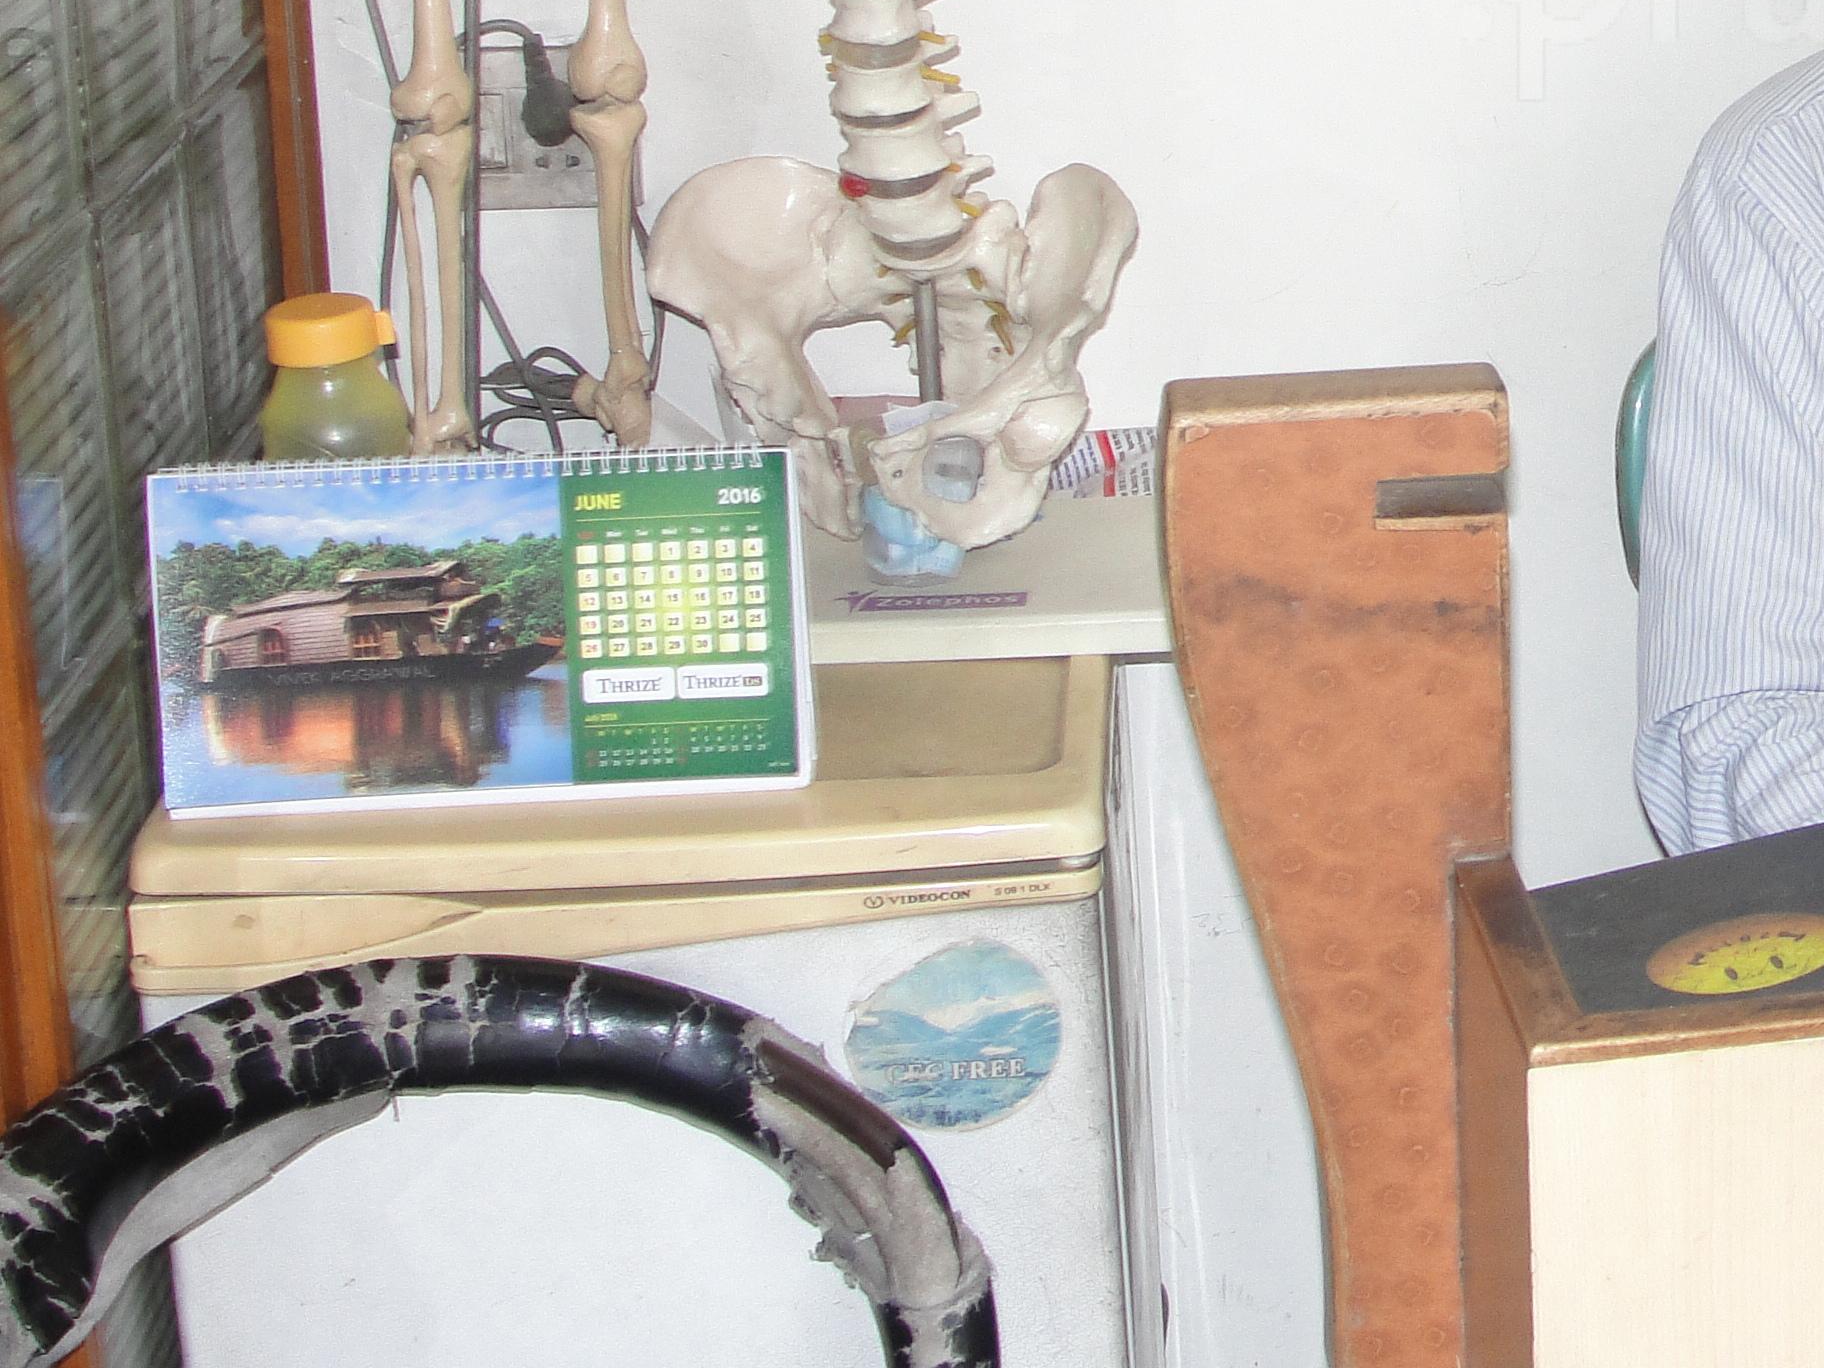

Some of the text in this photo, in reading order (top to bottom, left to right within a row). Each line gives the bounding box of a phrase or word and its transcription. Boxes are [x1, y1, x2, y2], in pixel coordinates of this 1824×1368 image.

[574, 488, 762, 511] JUNE 2016
[721, 568, 732, 576] 10
[749, 567, 759, 575] 11
[583, 590, 761, 606] 12 13 14 15 16 17 18
[876, 594, 1019, 607] Zolephos
[585, 614, 761, 629] 19 20 21 22 23 24 25
[585, 639, 708, 653] 26 27 28 29 30
[596, 677, 663, 694] THRIZE
[682, 674, 742, 690] THRIZE
[888, 889, 971, 905] VIDEOCON
[951, 1057, 1026, 1081] FREE
